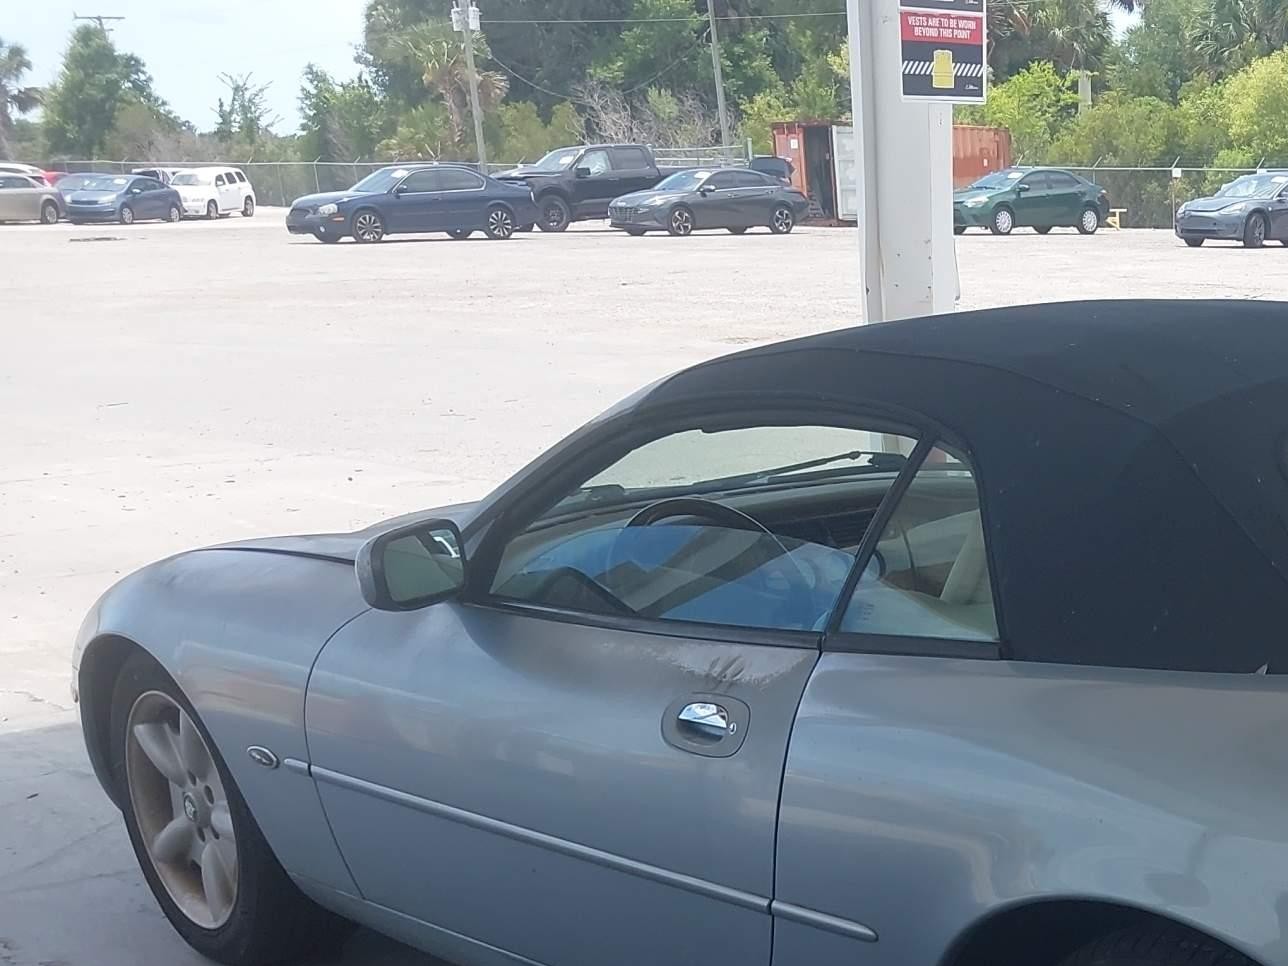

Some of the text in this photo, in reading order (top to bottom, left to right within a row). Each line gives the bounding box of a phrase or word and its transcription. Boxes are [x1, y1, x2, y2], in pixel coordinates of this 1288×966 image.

[907, 16, 976, 30] VESTS ARE TO BE WORN
[914, 27, 971, 40] BEYOND THIS POINT
